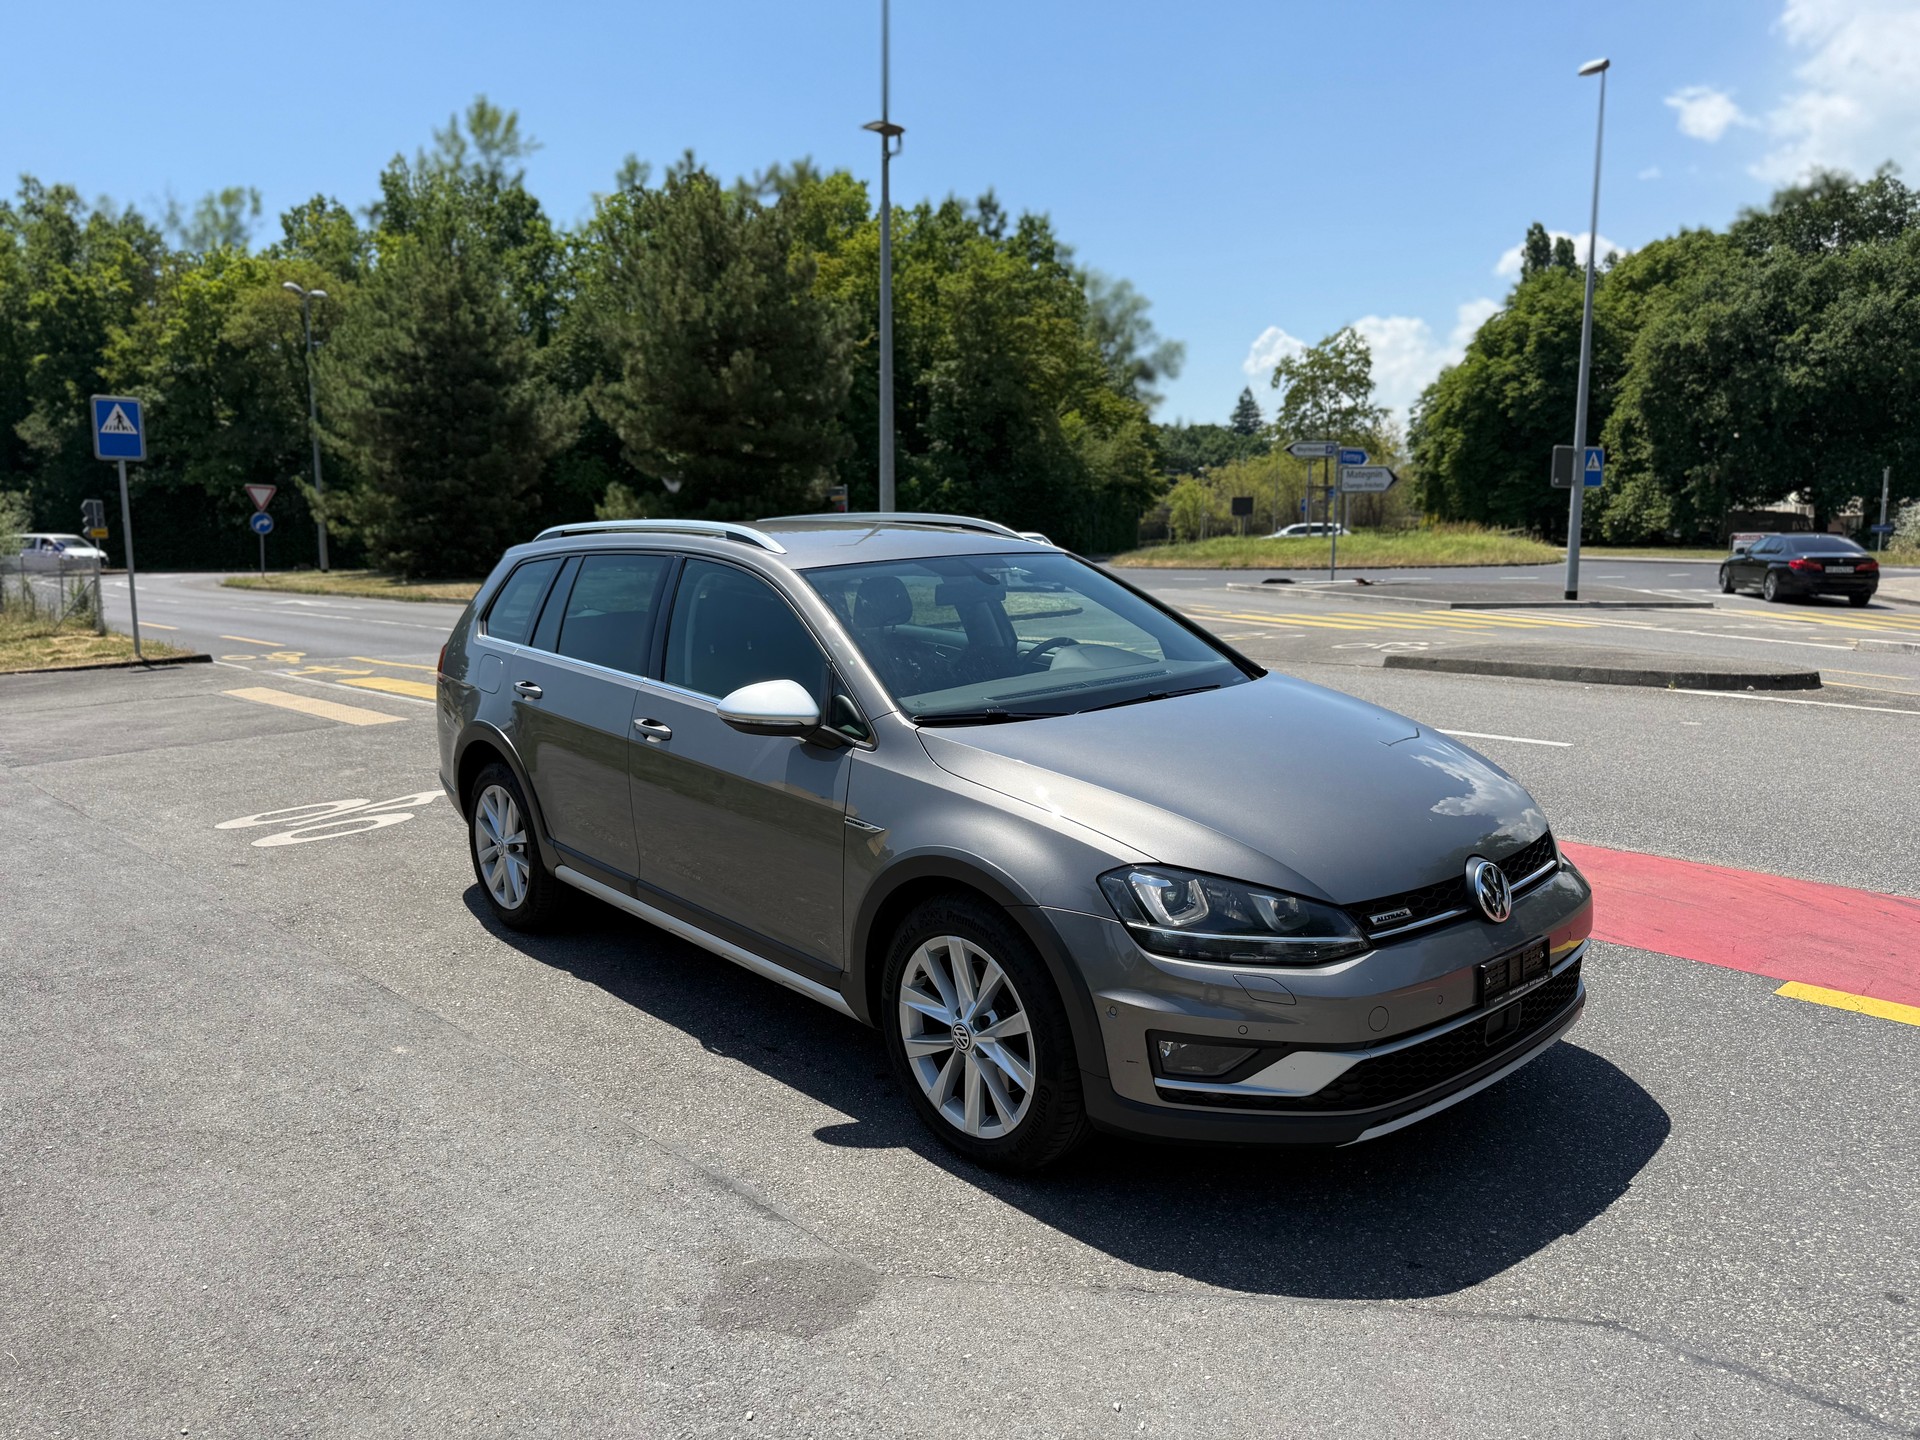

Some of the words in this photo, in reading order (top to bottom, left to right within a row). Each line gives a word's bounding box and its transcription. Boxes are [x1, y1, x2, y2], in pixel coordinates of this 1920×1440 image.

[1346, 469, 1383, 480] Mategnin
[1376, 909, 1408, 924] ALLTRACK
[946, 910, 1023, 975] PremiumContact
